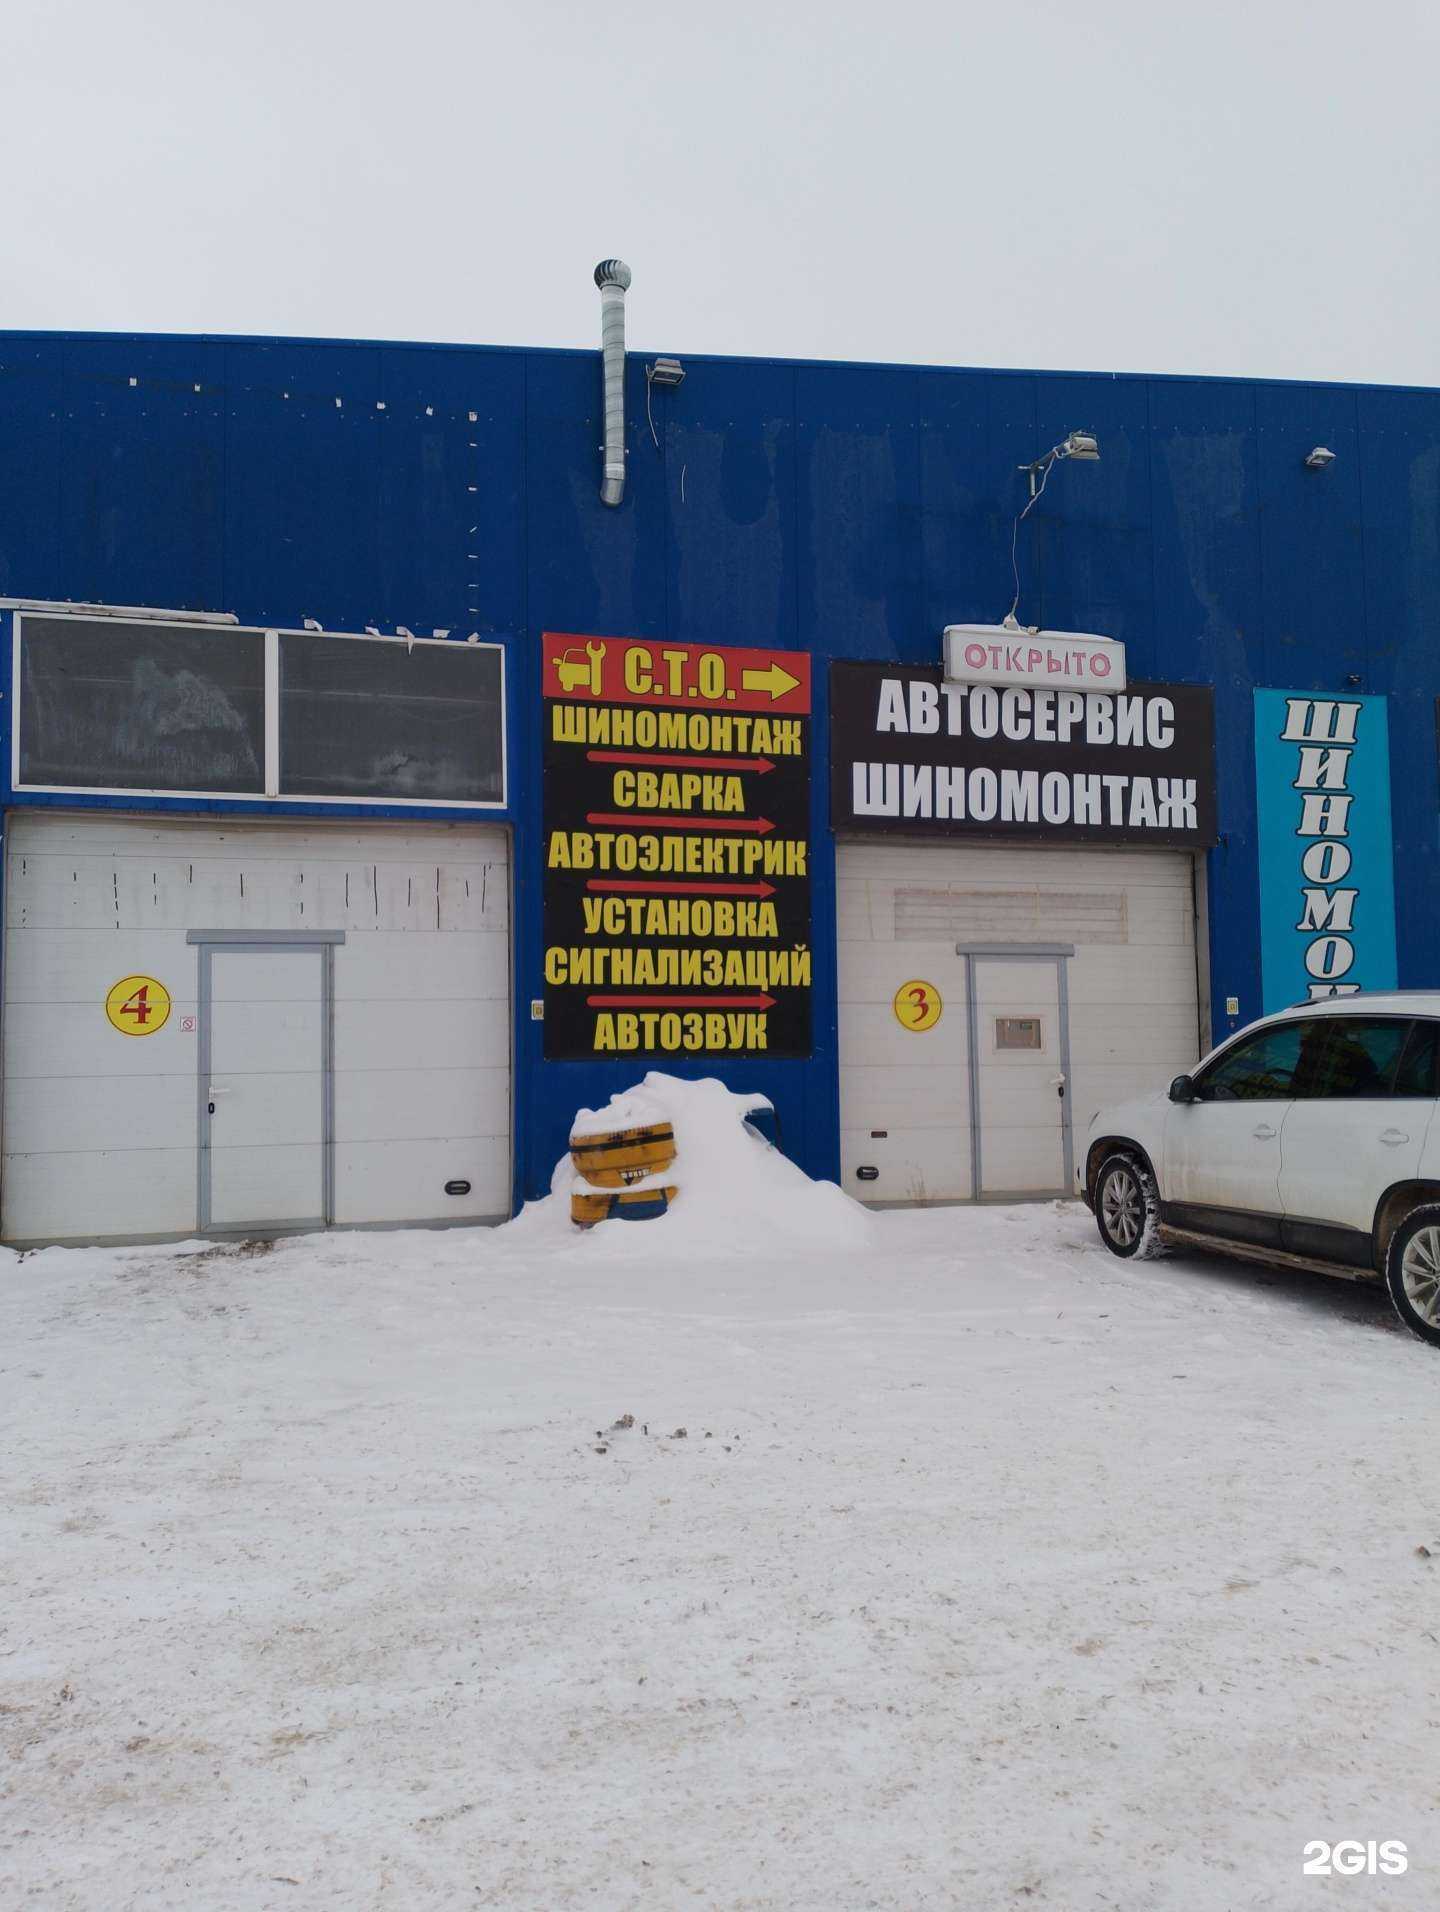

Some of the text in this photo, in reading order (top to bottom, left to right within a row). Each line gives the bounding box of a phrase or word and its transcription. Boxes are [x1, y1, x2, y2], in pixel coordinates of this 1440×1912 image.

[624, 647, 736, 699] С.Т.О.
[964, 643, 1111, 676] ОТКРЫТО
[552, 705, 802, 755] ШИНОМОНТАЖ
[876, 679, 1174, 748] АВТОСЕРВИС
[613, 770, 744, 812] СВАРКА
[852, 762, 1198, 829] ШИНОМОНТАЖ
[548, 831, 806, 876] АВТОЭЛЕКТРИК
[582, 897, 778, 937] УСТАНОВКА
[544, 943, 811, 991] СИГНАЛИЗАЦИЙ
[120, 985, 152, 1024] 4
[908, 988, 929, 1023] 3
[593, 1013, 767, 1050] АВТОЗВУК
